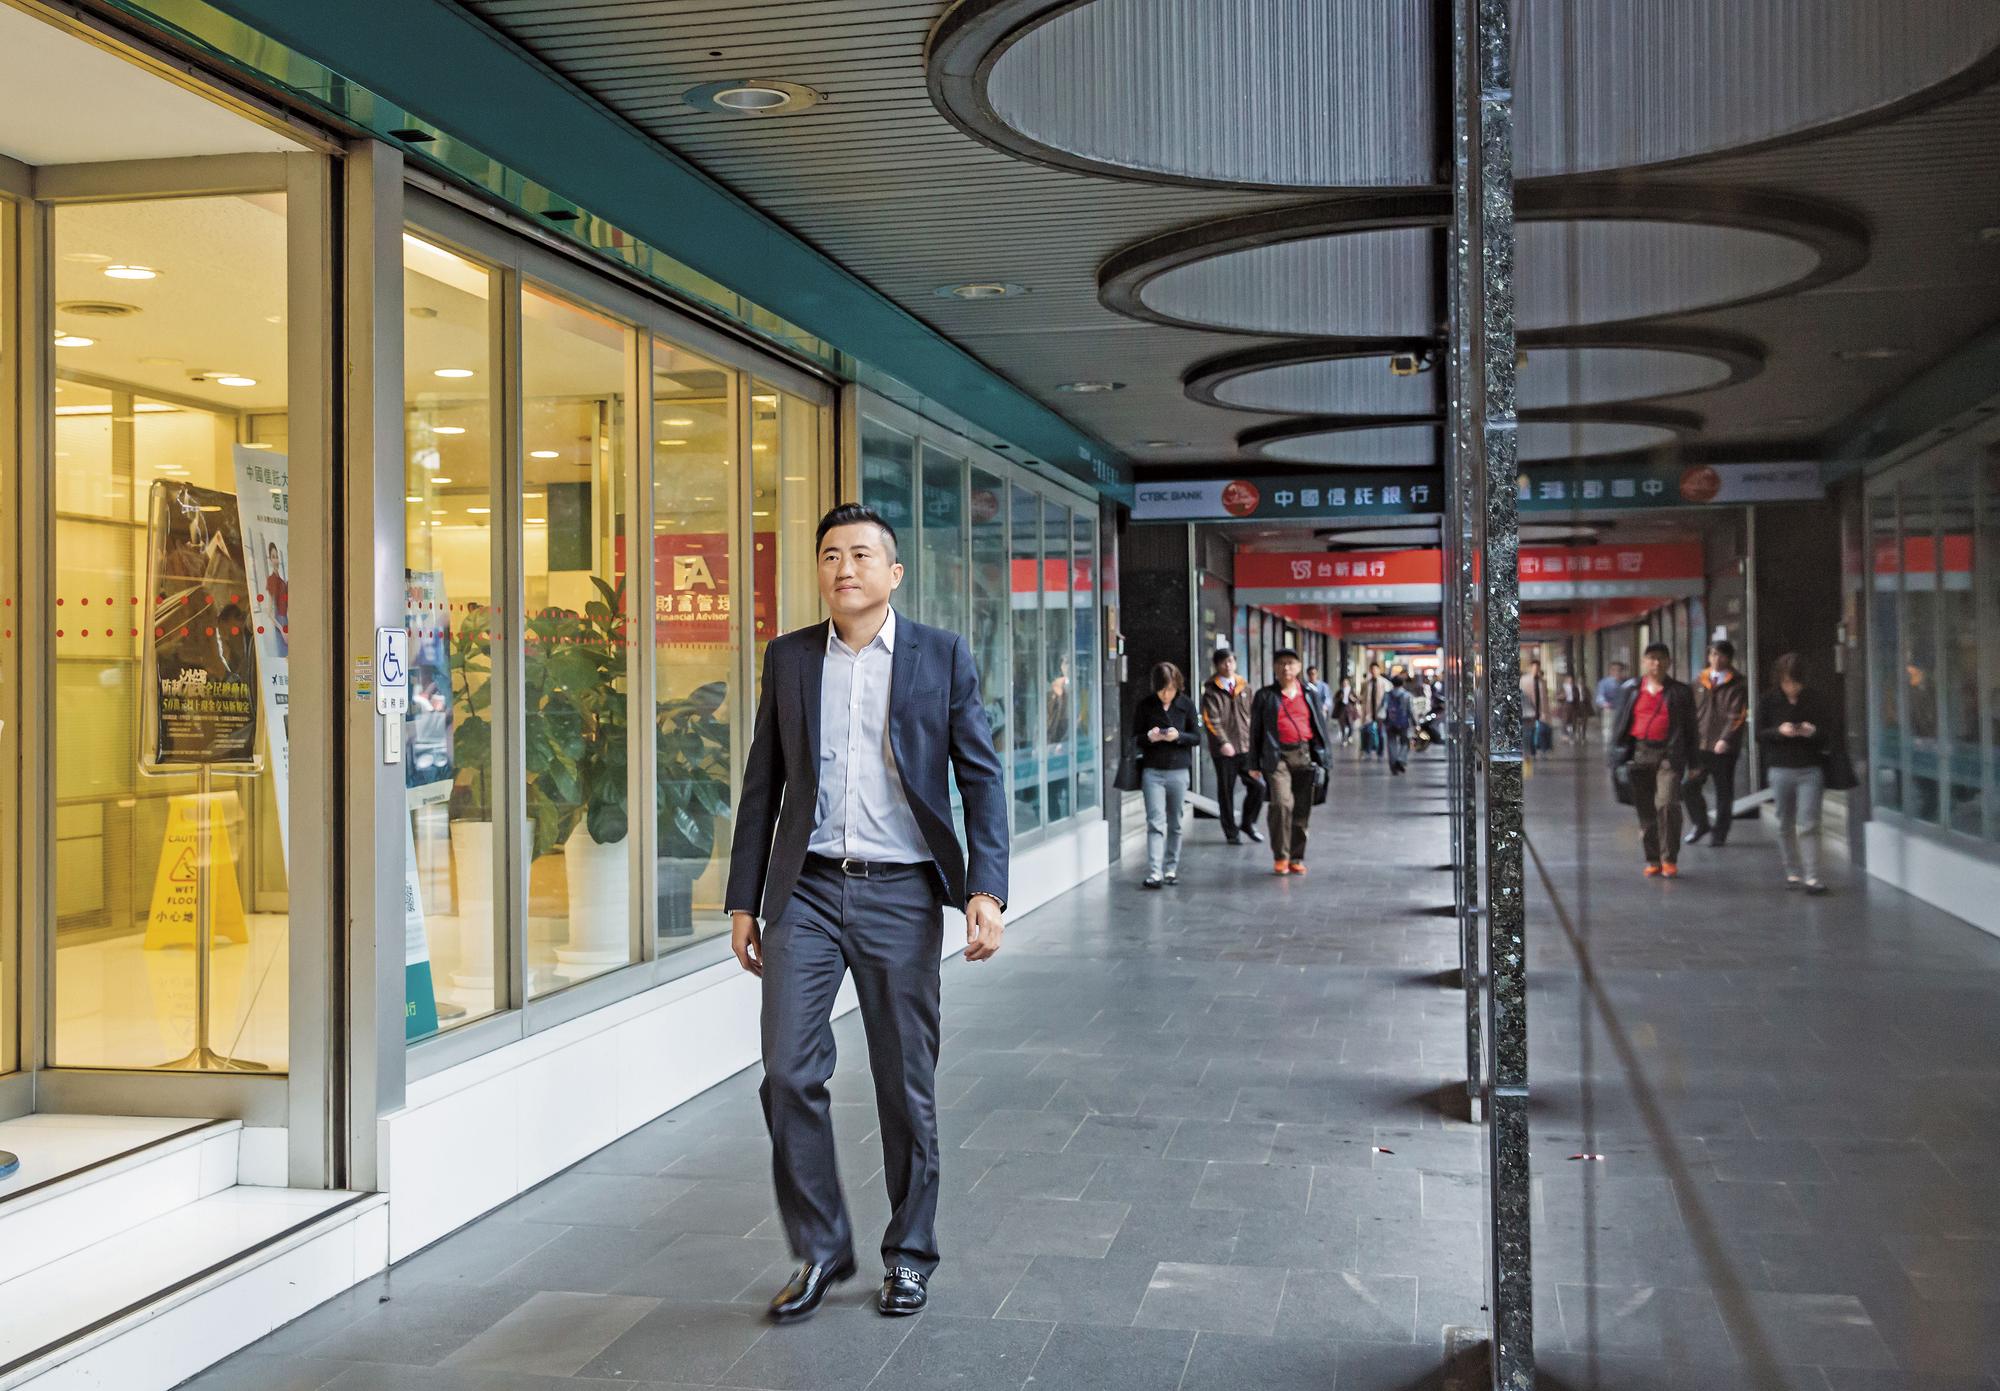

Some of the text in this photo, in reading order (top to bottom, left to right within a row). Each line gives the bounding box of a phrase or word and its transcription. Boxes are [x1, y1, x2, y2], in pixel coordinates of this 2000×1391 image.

[1139, 490, 1202, 502] CTBC BANK
[1274, 485, 1430, 507] 中國信託銀行
[1317, 560, 1386, 577] 台新銀行
[656, 594, 730, 612] 財富管理
[656, 613, 695, 621] Financial
[175, 886, 195, 894] WET
